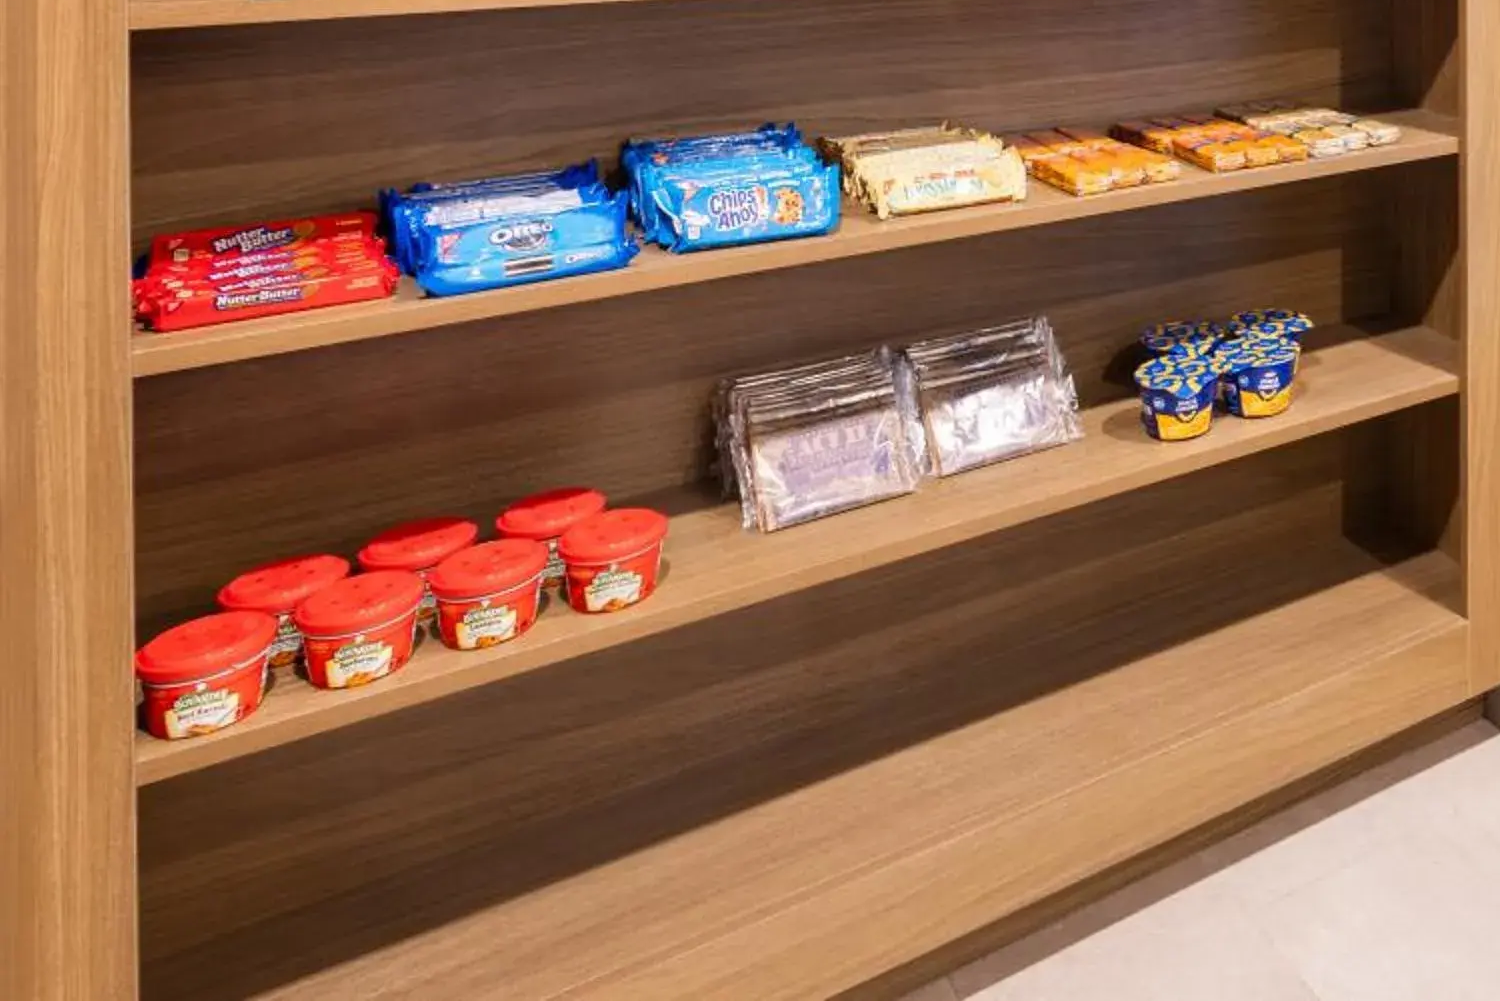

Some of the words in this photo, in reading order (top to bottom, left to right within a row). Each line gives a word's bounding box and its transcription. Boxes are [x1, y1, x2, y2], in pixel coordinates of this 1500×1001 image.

[710, 190, 757, 216] Chips
[214, 227, 265, 253] Nutter
[240, 229, 292, 253] Butter
